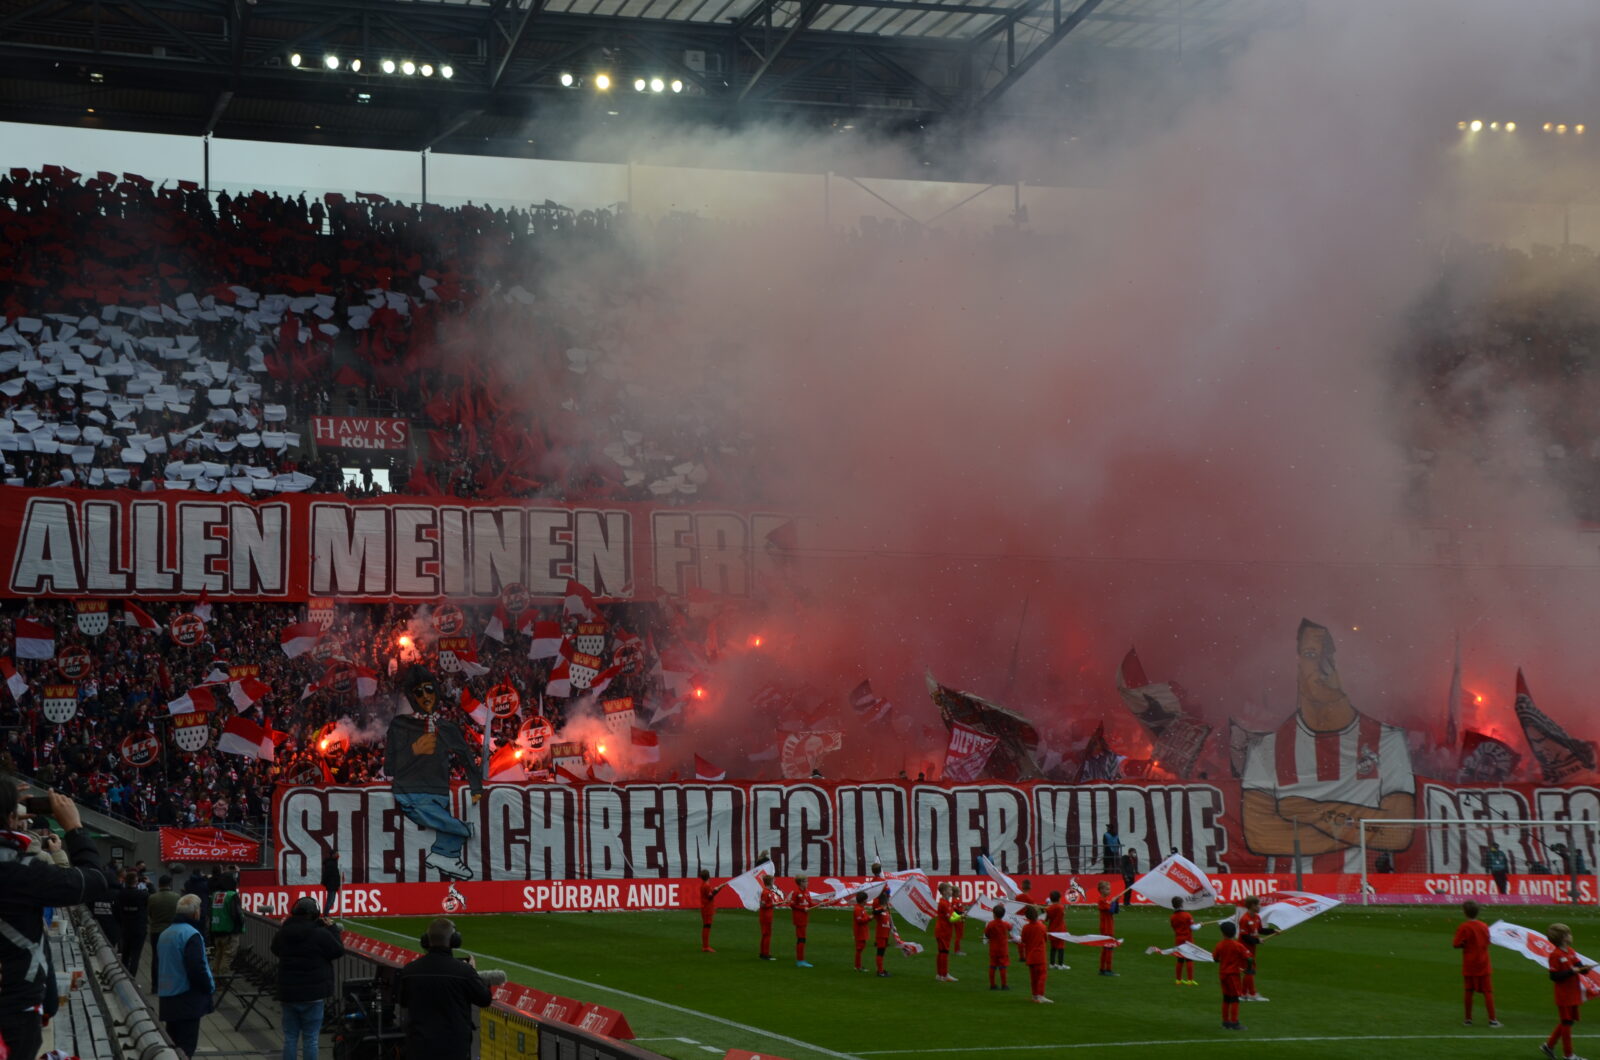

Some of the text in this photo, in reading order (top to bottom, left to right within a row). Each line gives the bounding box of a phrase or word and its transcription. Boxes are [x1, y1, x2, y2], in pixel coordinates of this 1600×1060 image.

[316, 418, 405, 443] HAWKS
[341, 435, 385, 449] KÖLN
[12, 499, 289, 595] ALLEN
[310, 504, 632, 597] MEINEN
[461, 787, 577, 882] ICH
[584, 785, 745, 879] BEIM
[750, 784, 833, 877] FC
[837, 785, 908, 876] IN
[912, 785, 1030, 876] DER
[1033, 785, 1228, 875] KURVE
[1425, 785, 1530, 874] DER
[174, 847, 249, 857] JECK OP FC
[234, 889, 289, 916] RBAR
[523, 881, 620, 909] SPÜRBAR
